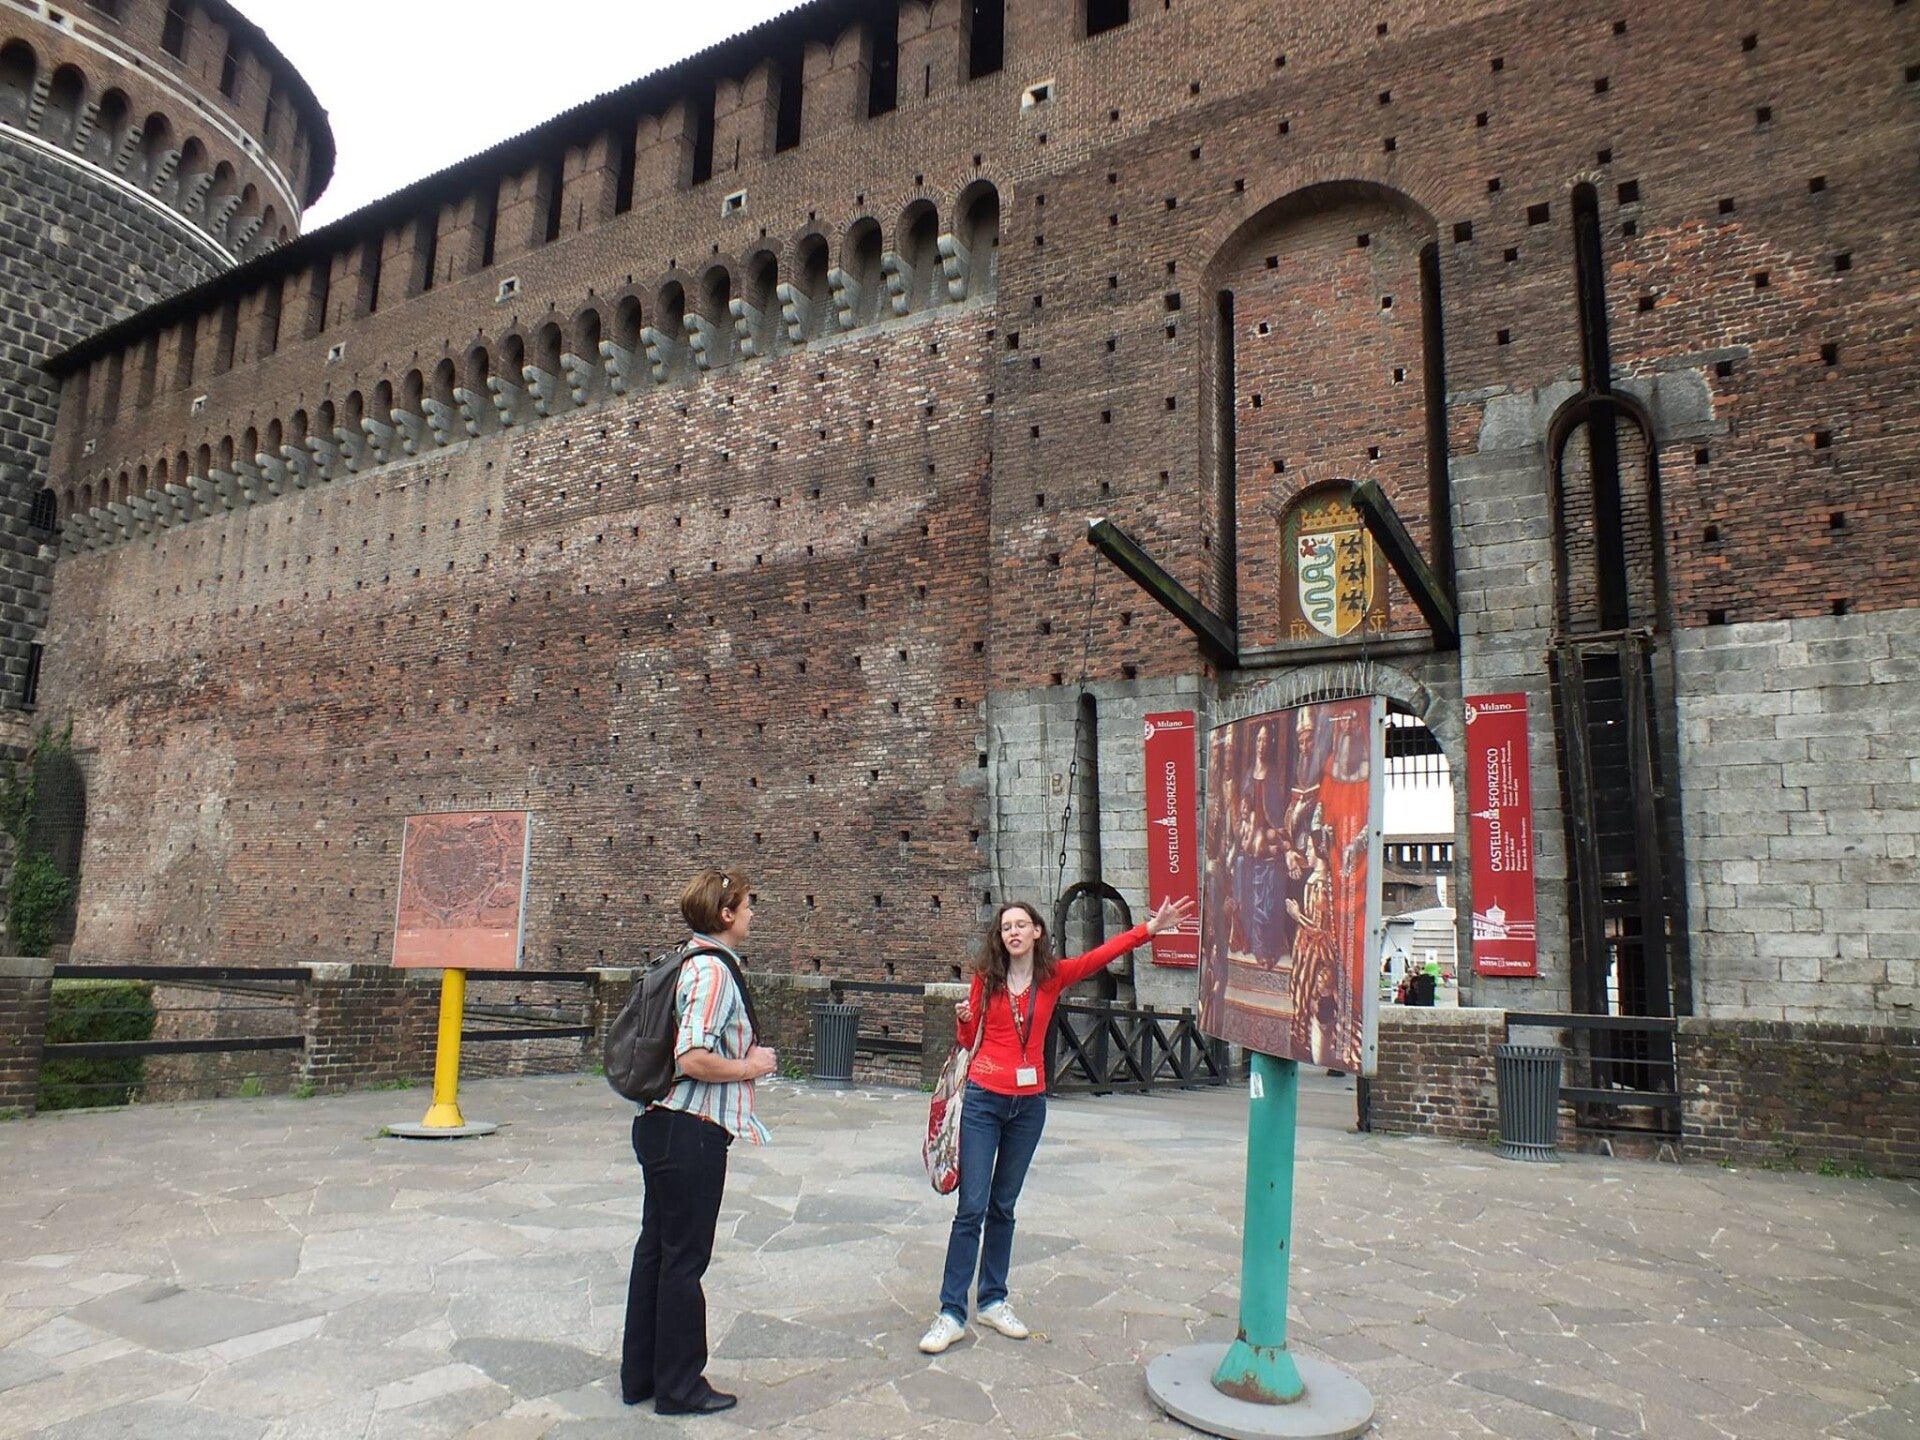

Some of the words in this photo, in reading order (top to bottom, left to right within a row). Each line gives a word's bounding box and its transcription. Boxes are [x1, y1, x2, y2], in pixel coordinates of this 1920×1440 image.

[1157, 720, 1183, 728] Milano
[1480, 703, 1512, 711] Milano
[1166, 761, 1177, 815] SFORZESCO
[1487, 747, 1500, 808] SFORZESCO
[1168, 828, 1179, 874] CASTELLO
[1489, 821, 1502, 872] CASTELLO
